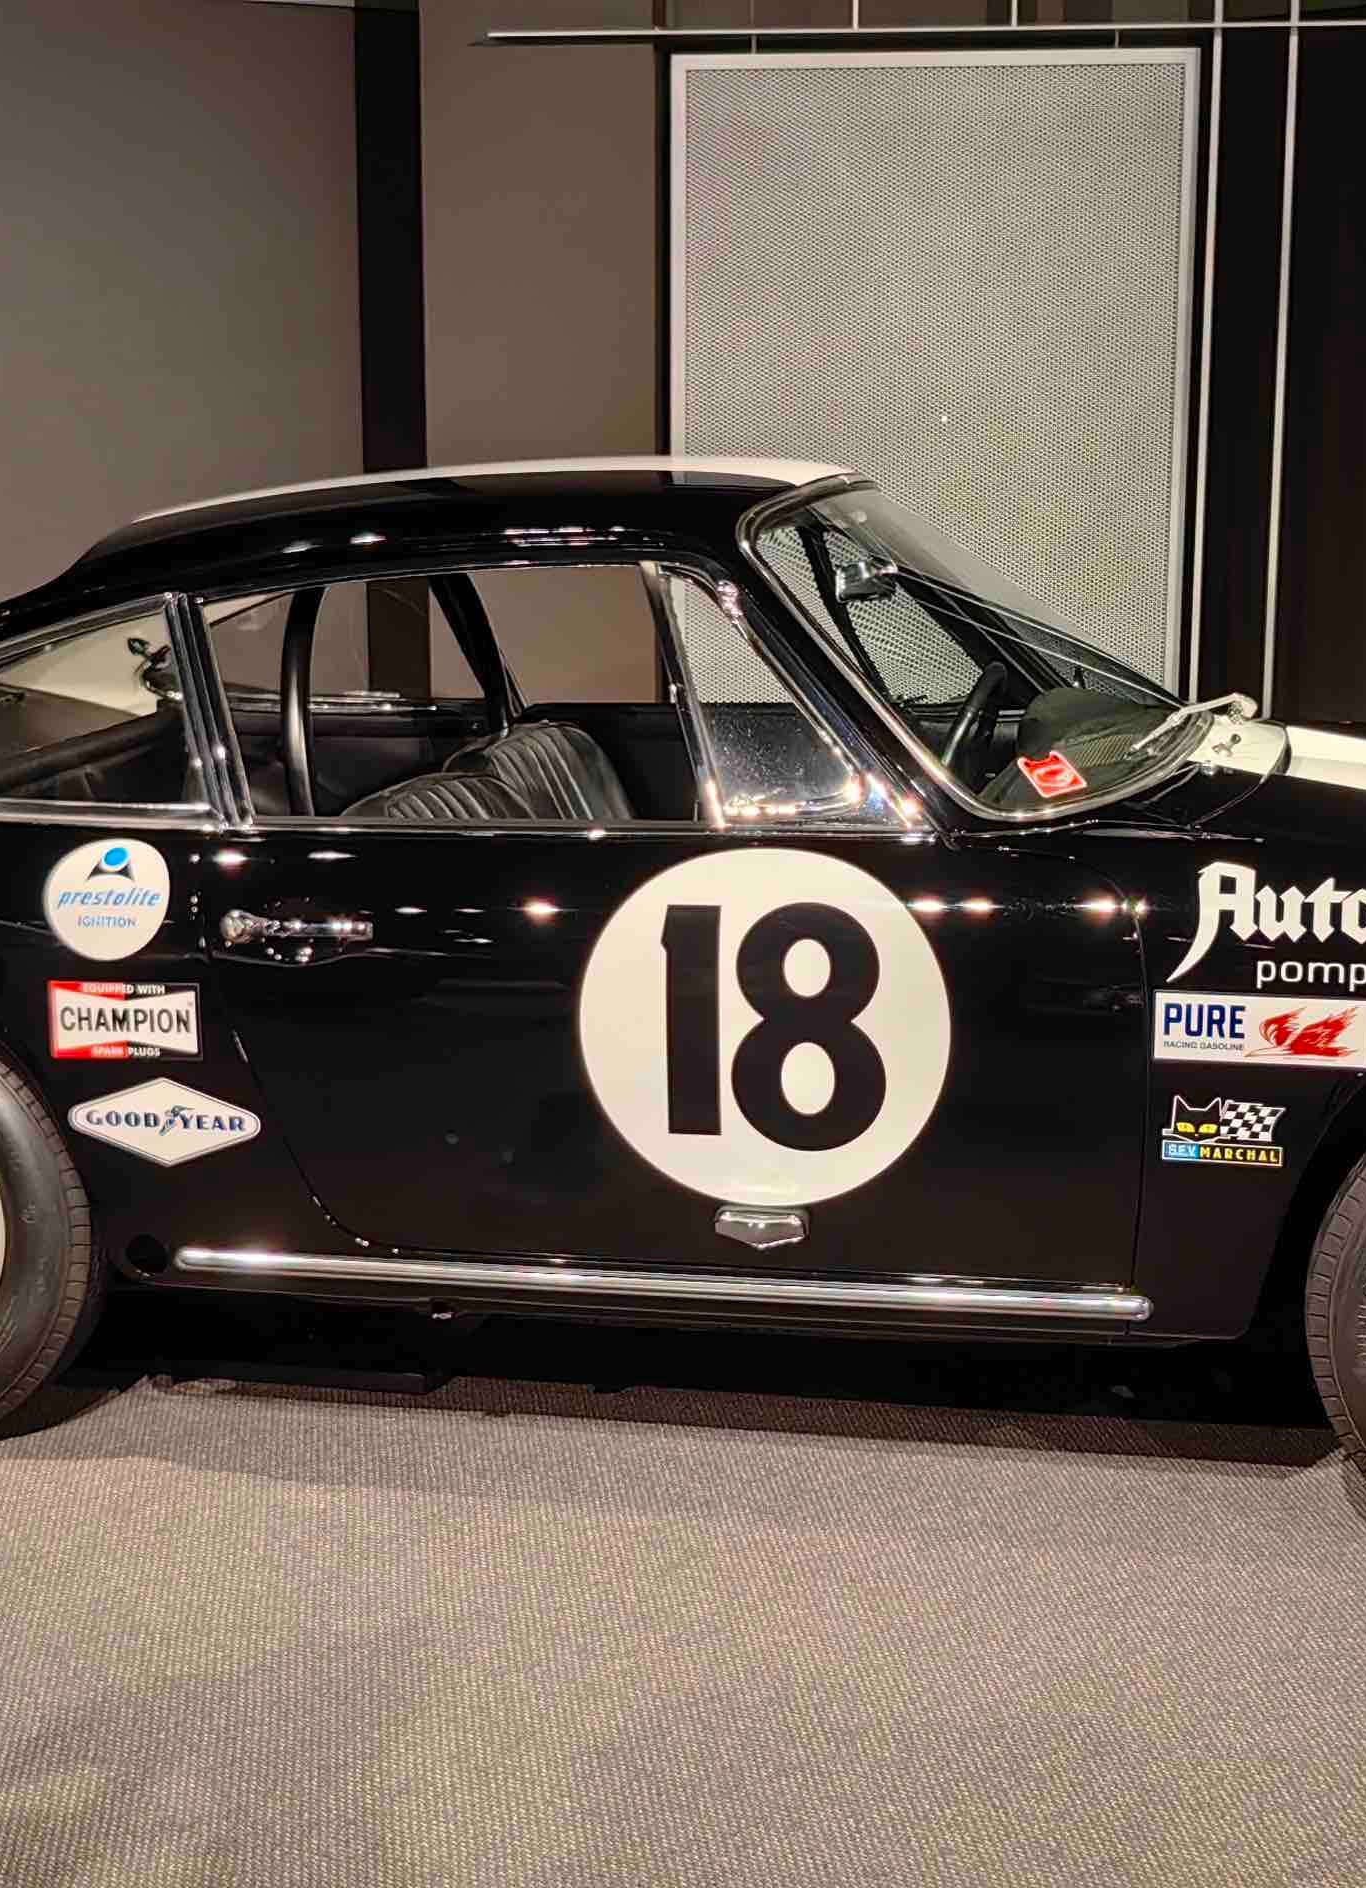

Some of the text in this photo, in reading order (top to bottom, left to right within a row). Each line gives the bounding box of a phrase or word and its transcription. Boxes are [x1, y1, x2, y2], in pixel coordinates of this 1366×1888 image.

[57, 887, 162, 910] prestolite
[76, 915, 137, 928] IGNITION
[82, 982, 165, 995] EQUIPPED WITH
[59, 1006, 192, 1033] CHAMPION
[660, 901, 887, 1152] 18
[1162, 1003, 1247, 1039] PURE
[127, 1047, 161, 1058] PLUGS
[1163, 1040, 1244, 1052] RACING GASOLINE
[1199, 1145, 1279, 1163] MARCHAL
